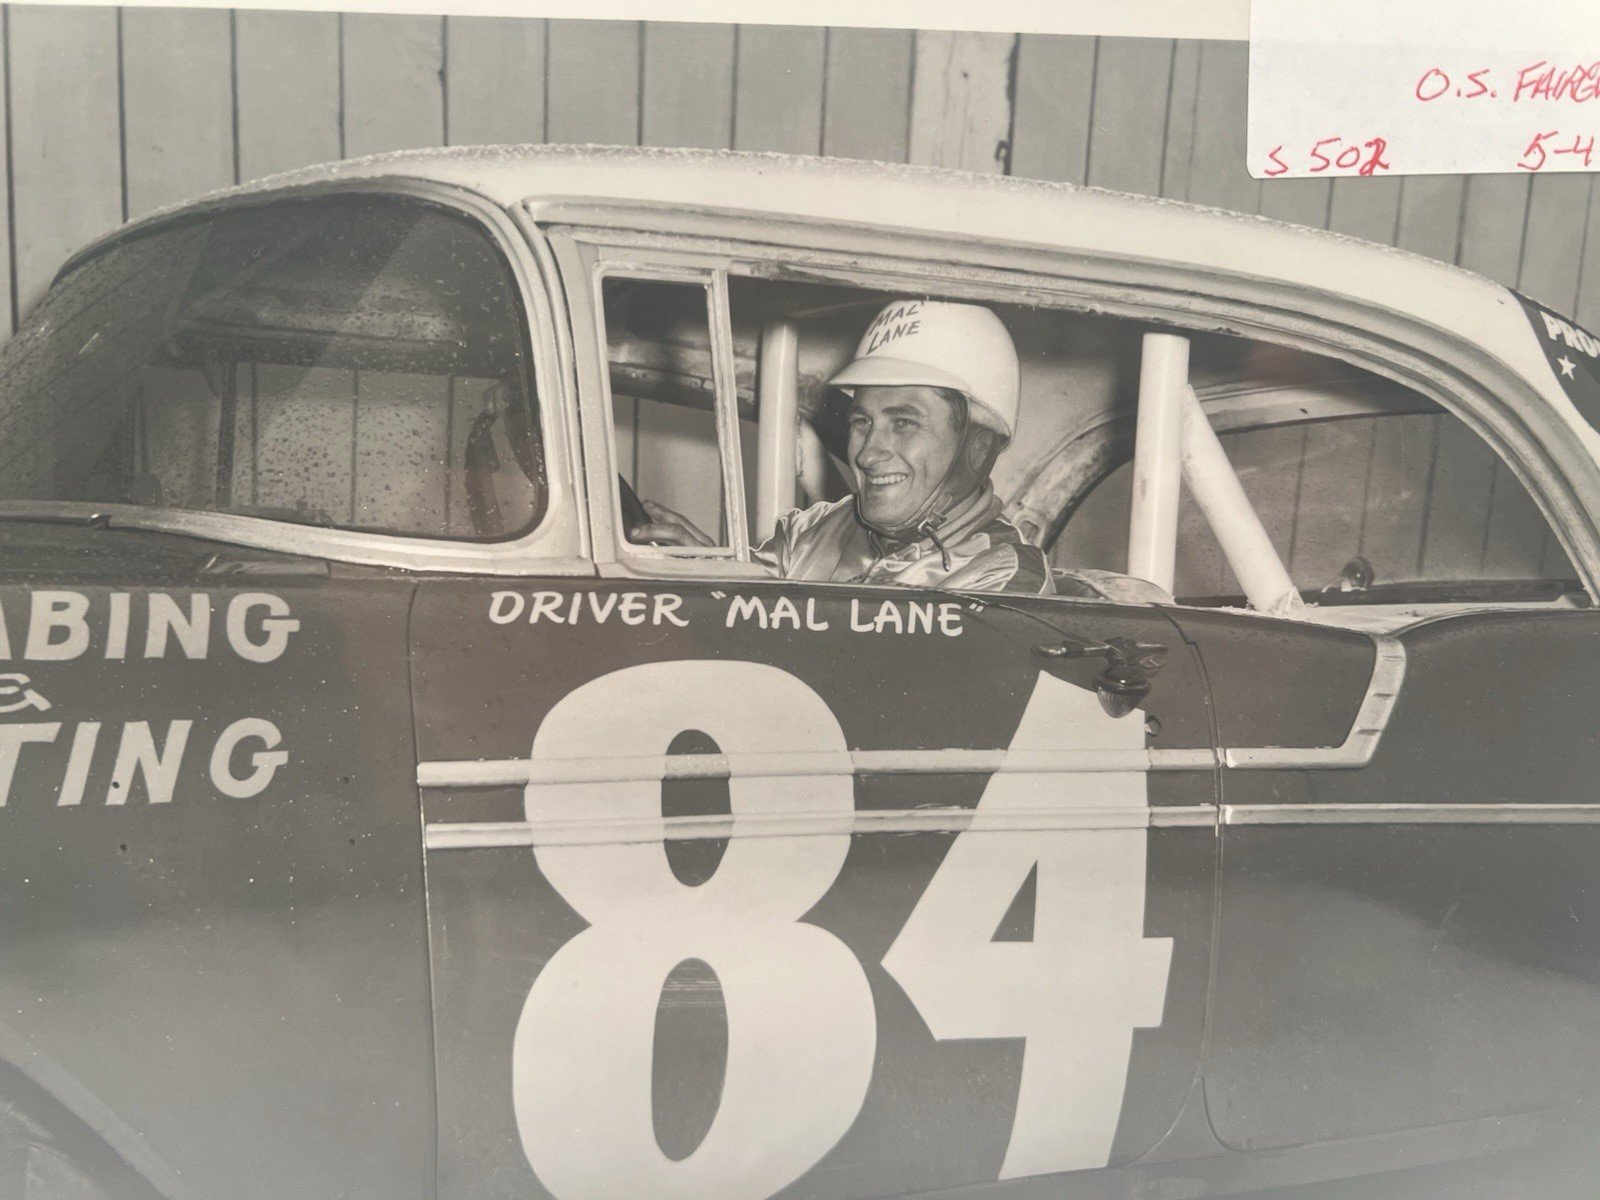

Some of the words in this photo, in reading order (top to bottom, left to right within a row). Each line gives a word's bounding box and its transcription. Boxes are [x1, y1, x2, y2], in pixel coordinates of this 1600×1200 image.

[1416, 68, 1497, 102] O.S.
[866, 320, 922, 356] LANE
[488, 591, 690, 628] DRIVER
[512, 660, 1174, 1200] 84
